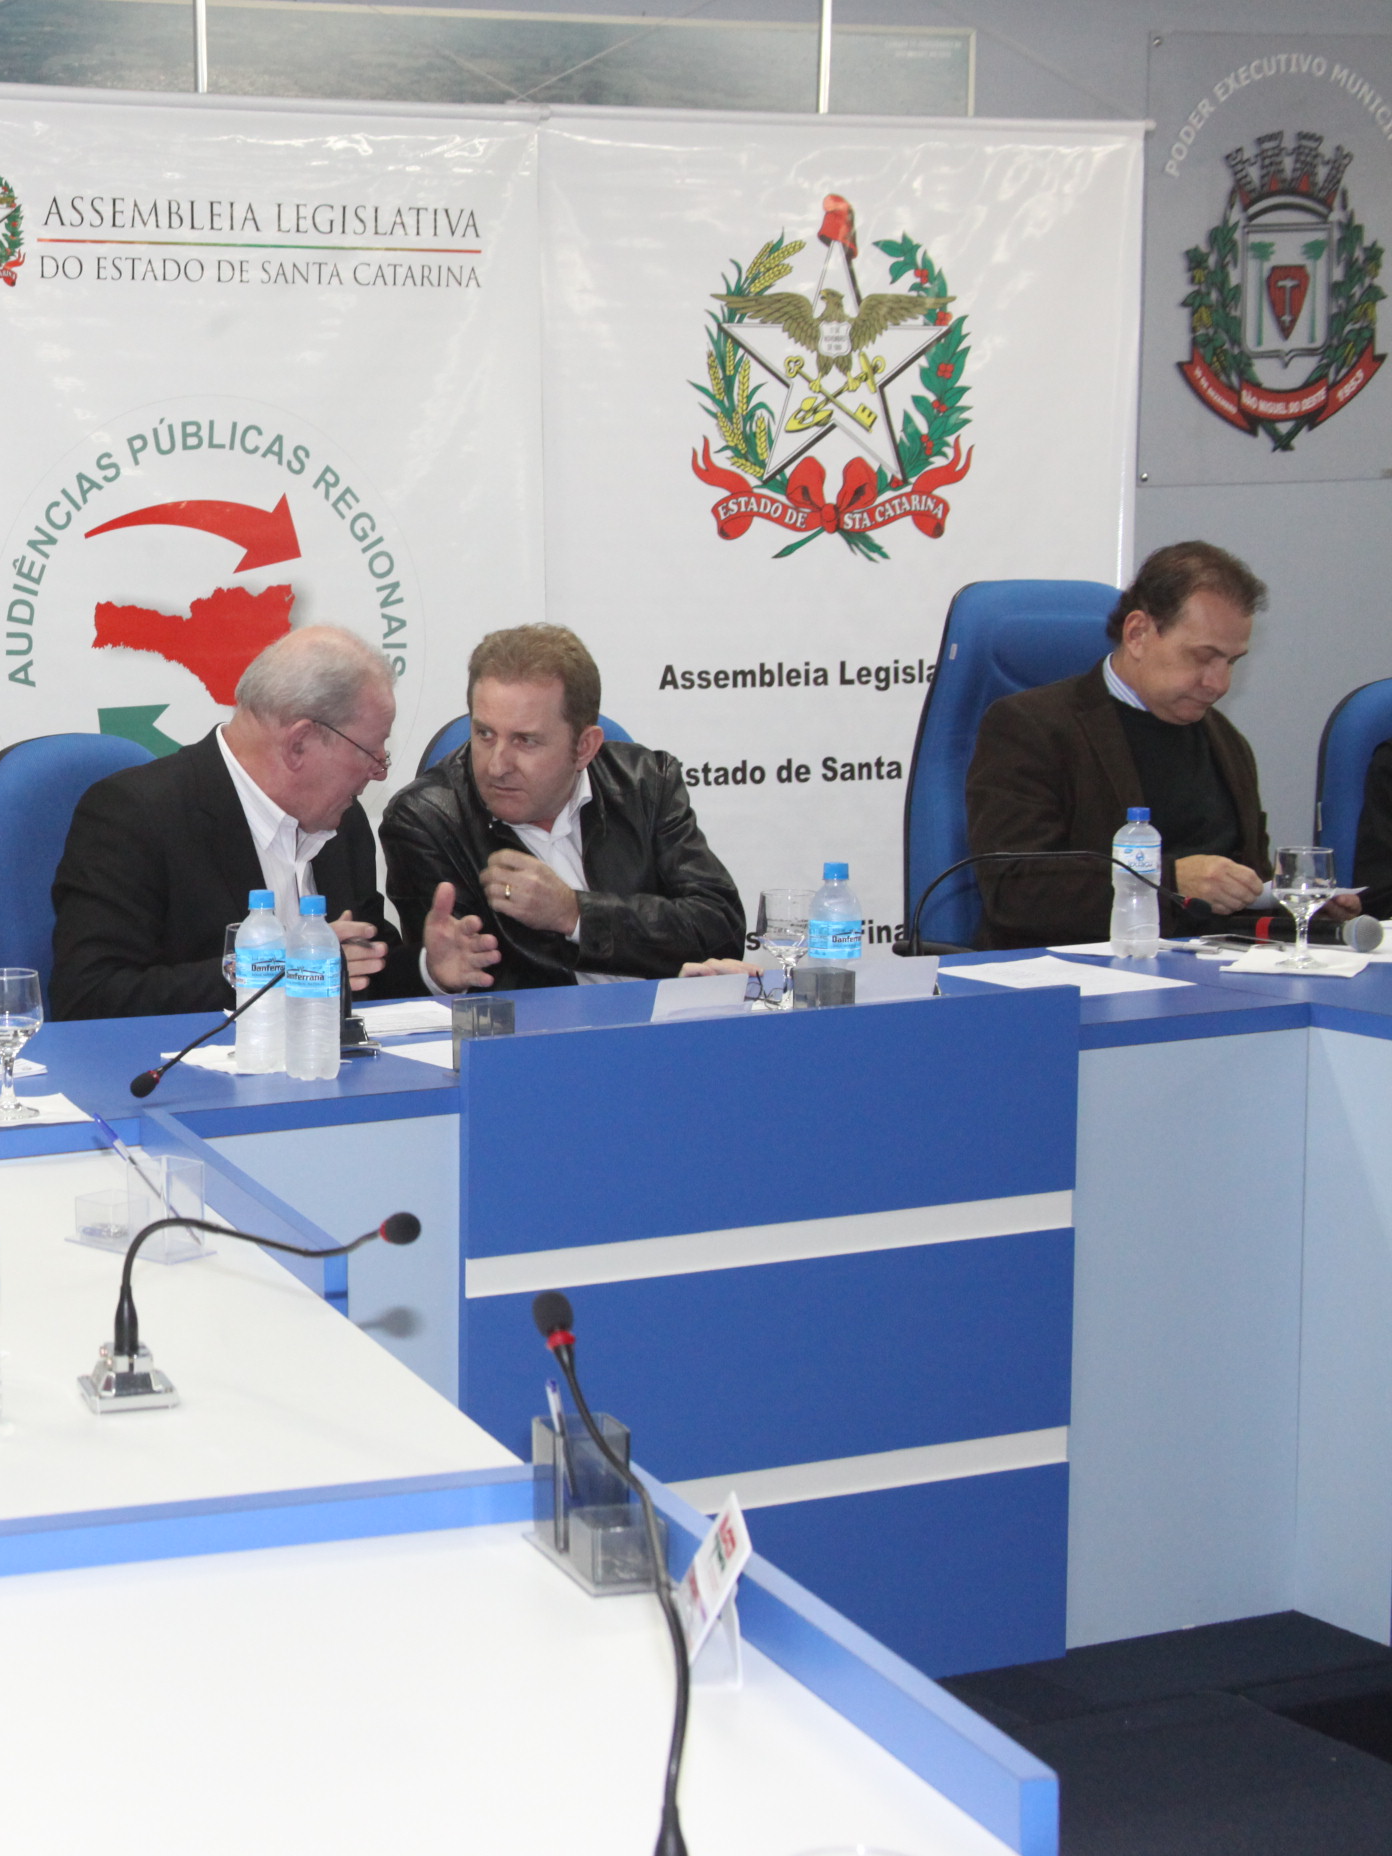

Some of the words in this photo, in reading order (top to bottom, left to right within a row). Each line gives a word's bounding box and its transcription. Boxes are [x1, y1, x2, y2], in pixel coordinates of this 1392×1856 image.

[1164, 98, 1217, 178] PODER
[1213, 53, 1328, 103] EXECUTIVO
[1329, 63, 1392, 140] MUNICI
[42, 195, 261, 233] ASSEMBLEIA
[276, 202, 481, 239] LEGISLATIVA
[39, 254, 83, 280] DO
[96, 256, 204, 283] ESTADO
[216, 259, 251, 285] DE
[260, 261, 344, 286] SANTA
[352, 262, 482, 289] CATARINA
[717, 497, 783, 520] ESTADO
[784, 508, 808, 529] DE
[874, 494, 944, 521] CATARINA
[5, 451, 122, 688] AUDIÊNCIAS
[126, 417, 311, 476] PÚBLICAS
[312, 464, 408, 678] REGIONAIS
[659, 661, 829, 690] Assembleia
[839, 659, 935, 691] Legisla
[679, 759, 766, 787] stado
[776, 758, 811, 783] de
[821, 756, 903, 781] Santa
[251, 964, 285, 973] Danferra
[286, 972, 325, 981] anferrana
